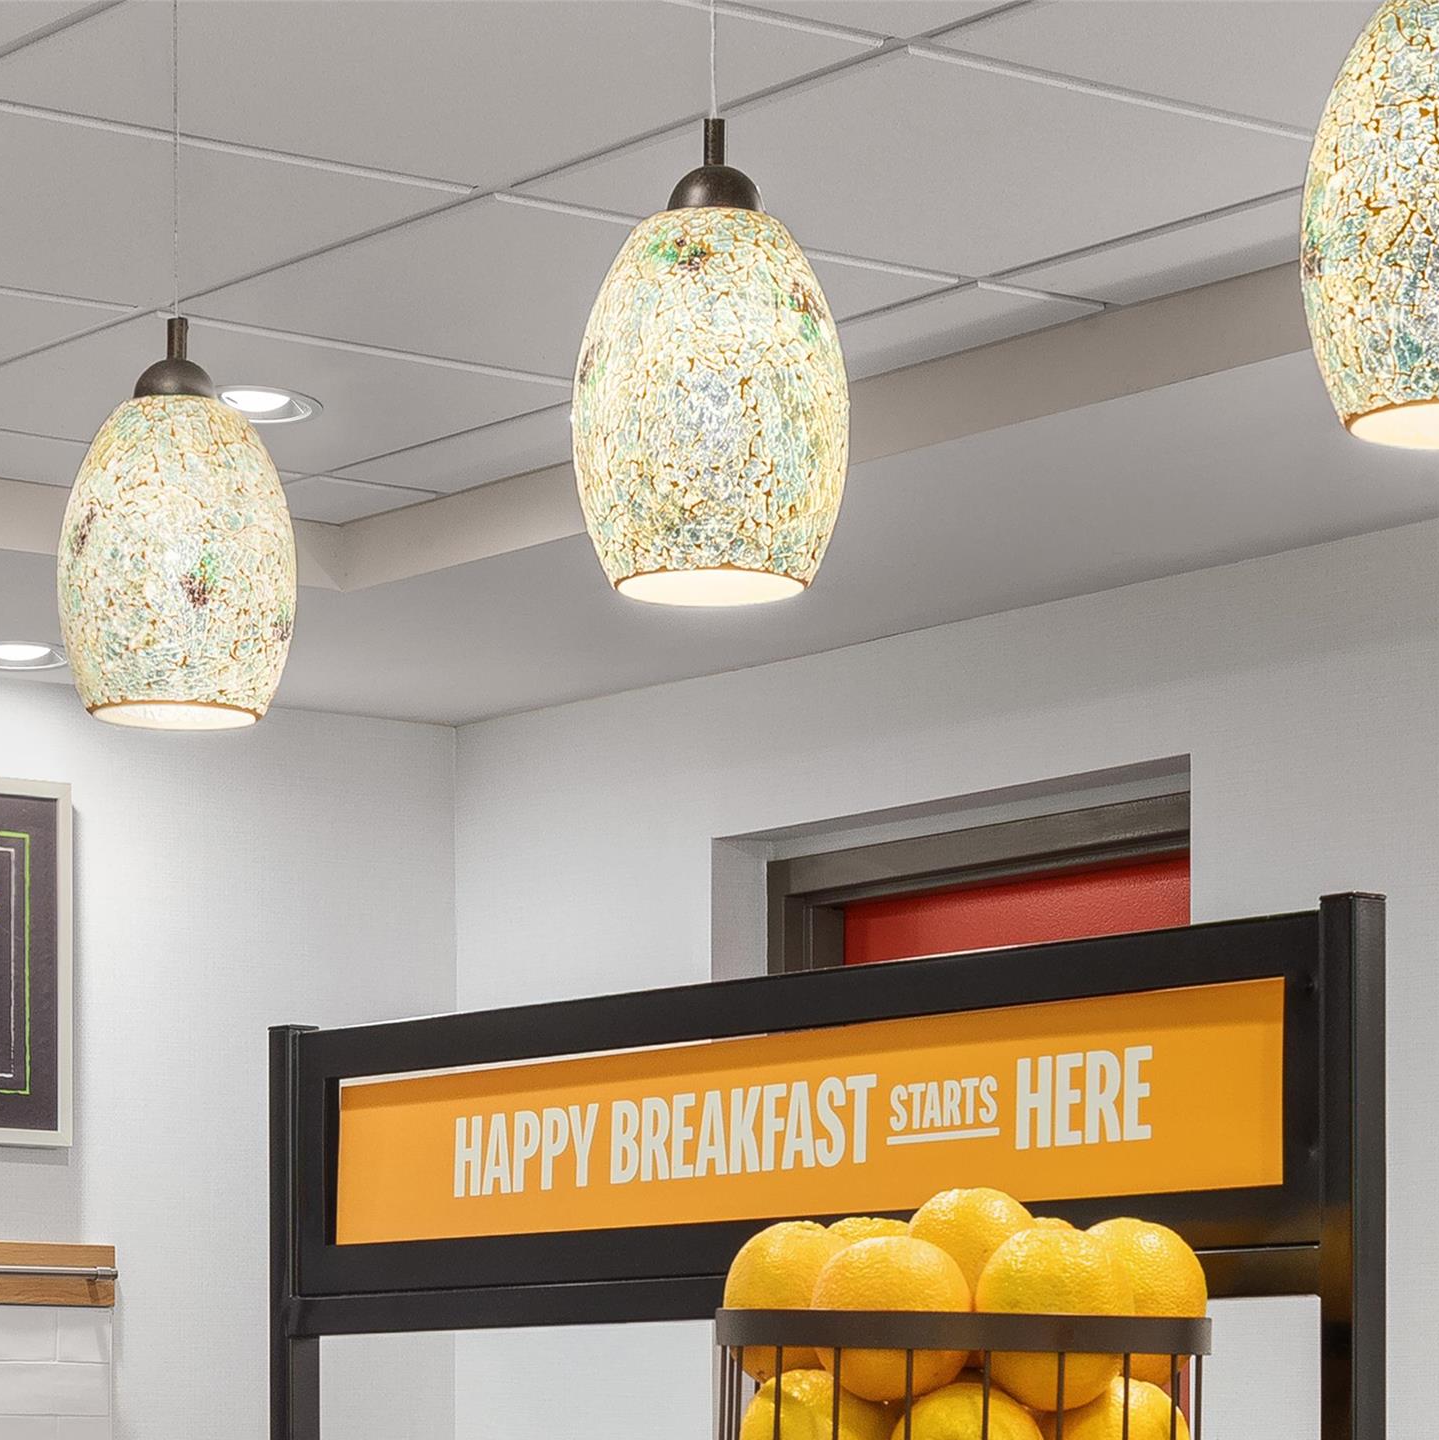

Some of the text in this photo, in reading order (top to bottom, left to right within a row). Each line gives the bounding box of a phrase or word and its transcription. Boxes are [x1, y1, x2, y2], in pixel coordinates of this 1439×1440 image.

[453, 1044, 1154, 1199] HAPPY BREAKFAST STARTS HERE
